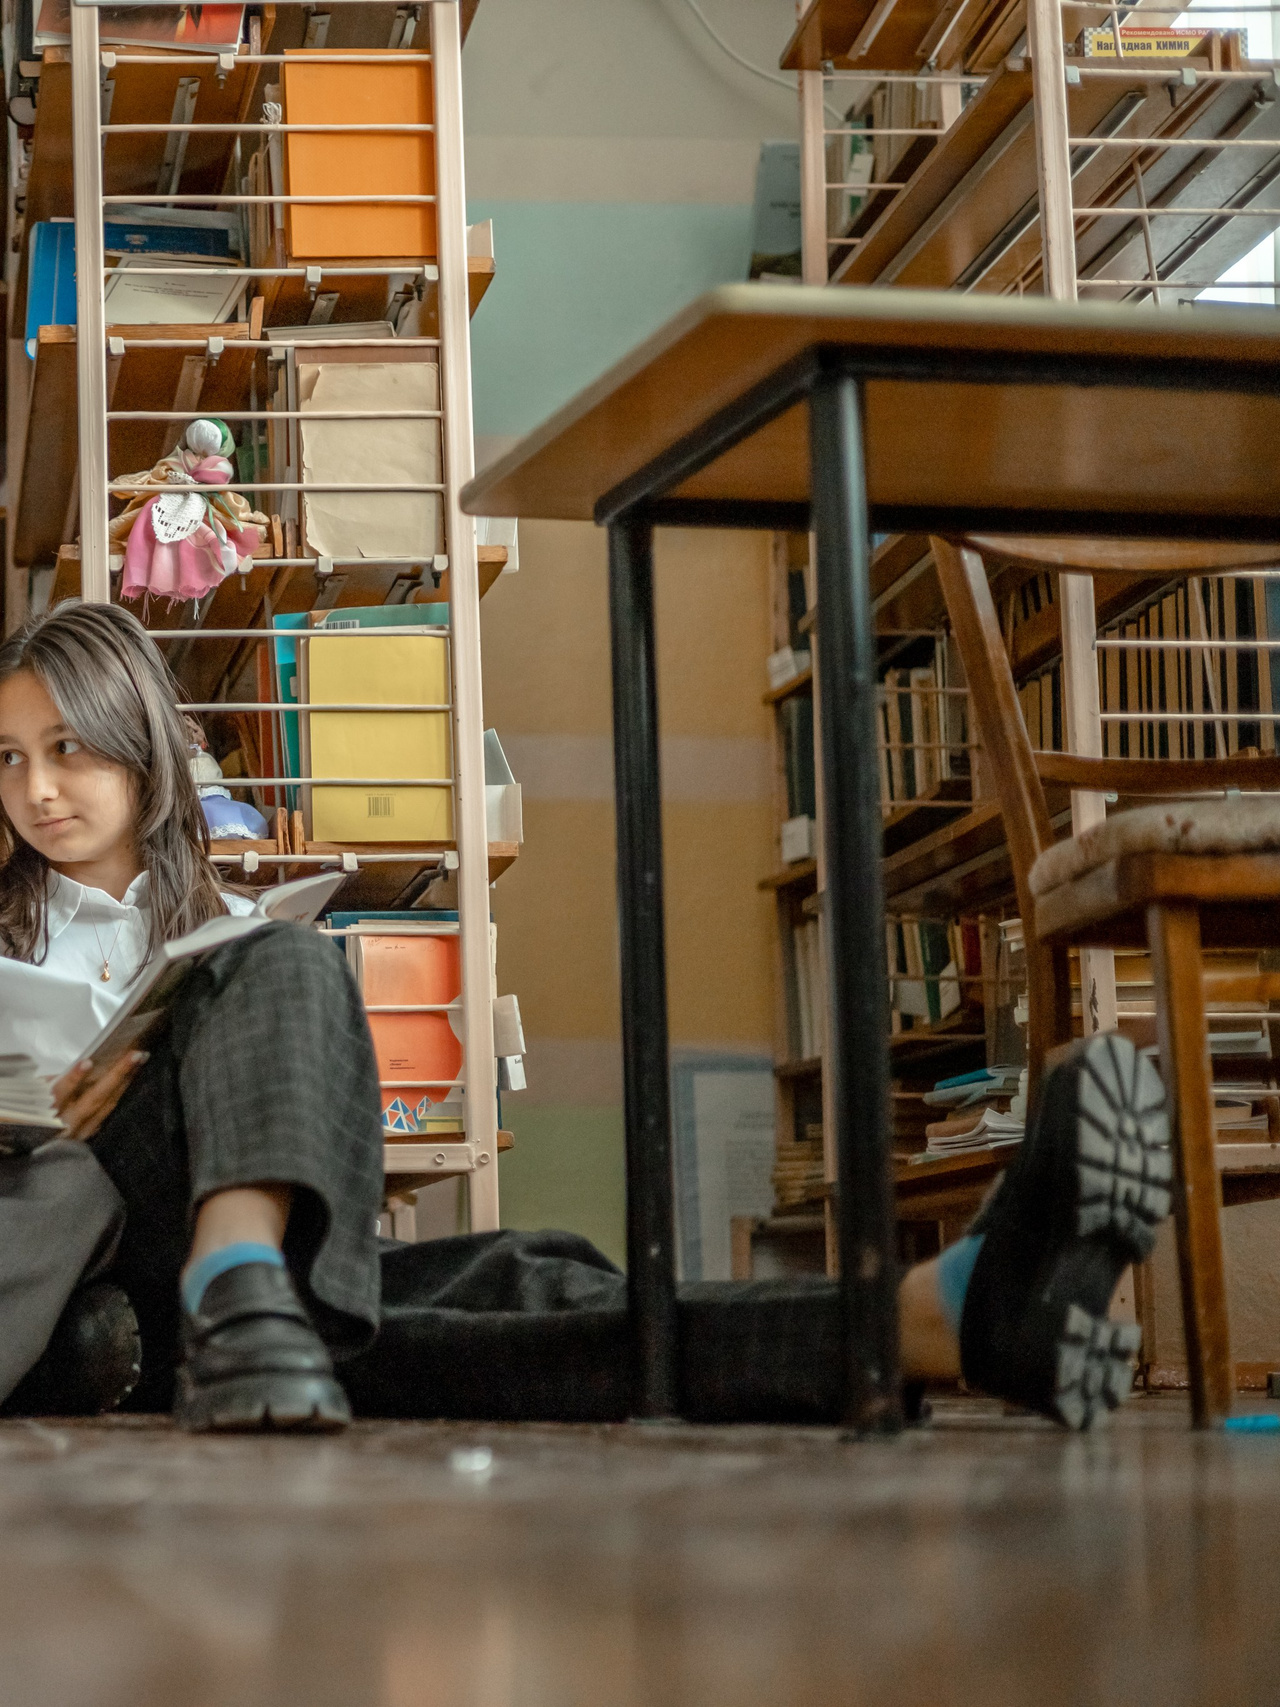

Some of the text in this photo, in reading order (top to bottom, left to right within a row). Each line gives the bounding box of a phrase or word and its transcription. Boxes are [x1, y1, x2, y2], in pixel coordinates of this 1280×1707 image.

[1121, 29, 1175, 37] Рекомендовано
[1096, 40, 1190, 51] Нагядная ХИМИЯ
